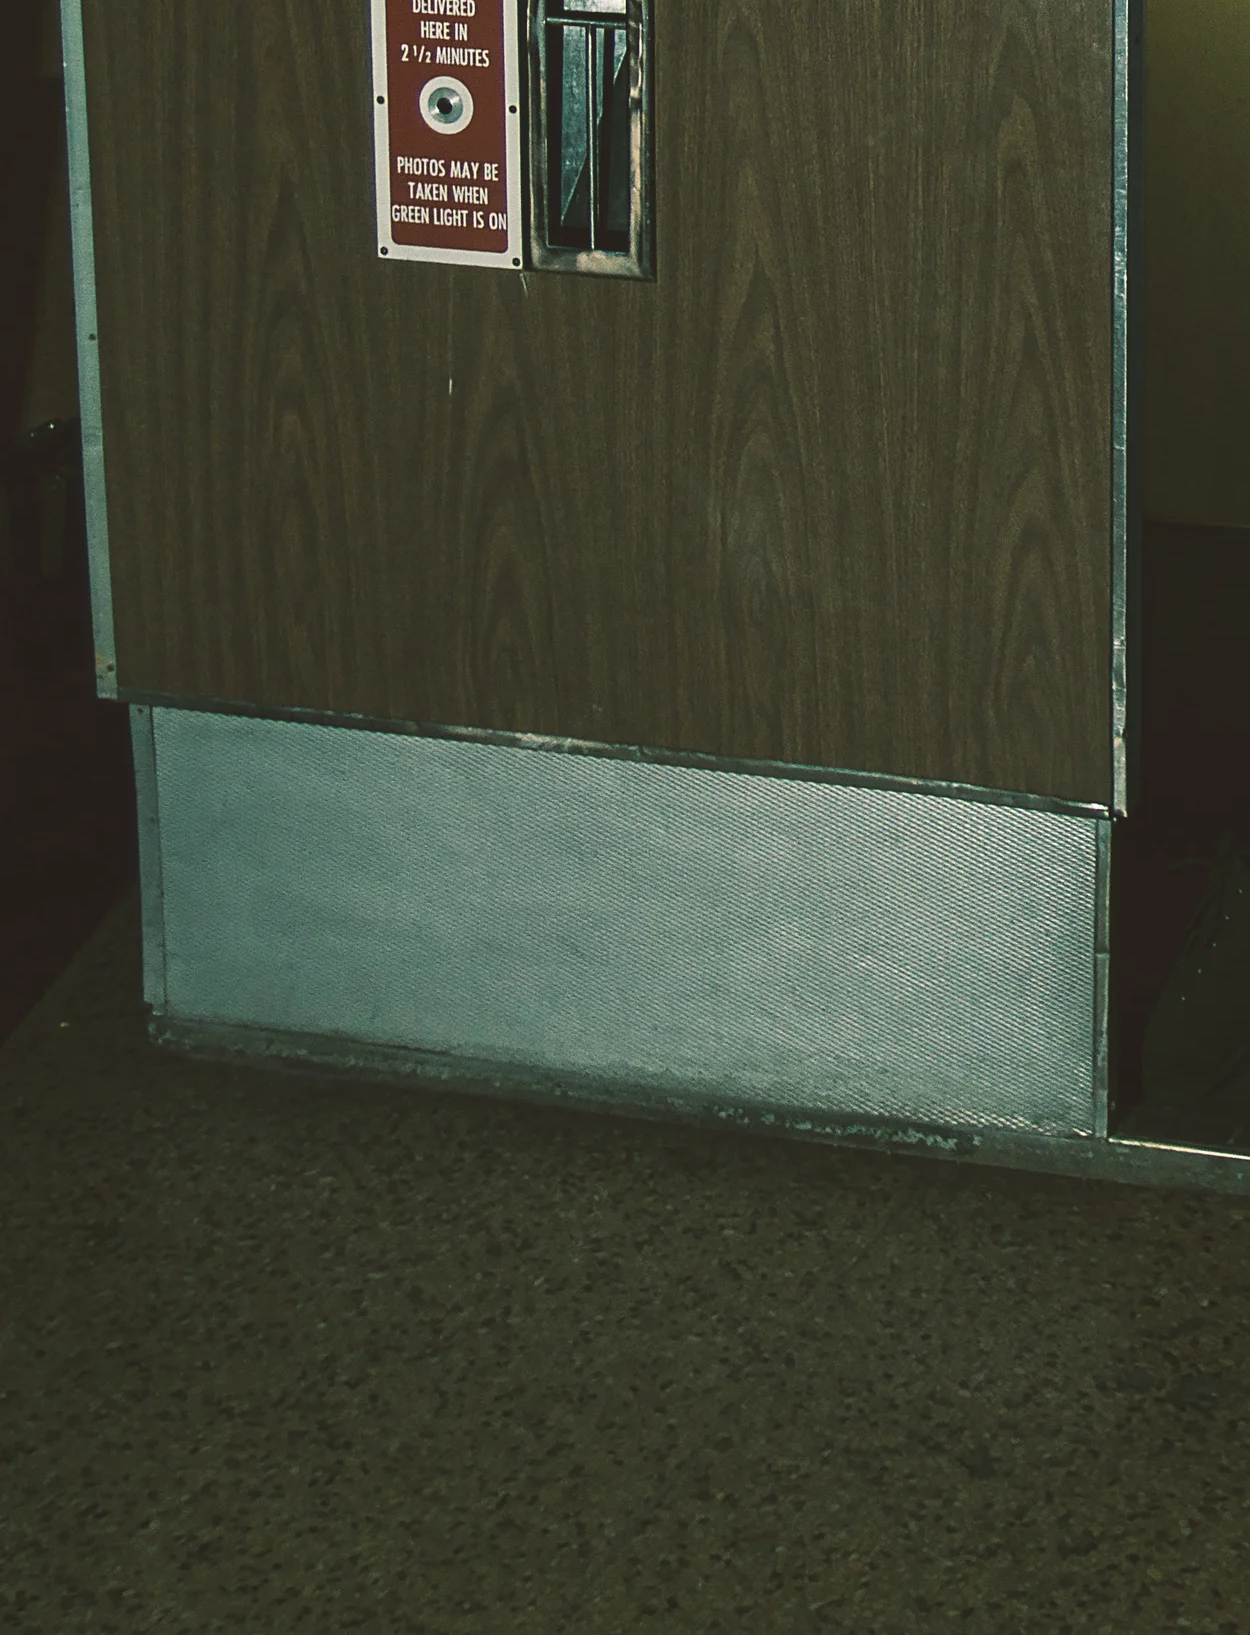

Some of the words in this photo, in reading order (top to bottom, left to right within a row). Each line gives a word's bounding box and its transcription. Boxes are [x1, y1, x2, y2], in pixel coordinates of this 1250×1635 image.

[420, 20, 451, 41] HERE
[454, 22, 468, 42] IN
[435, 45, 490, 68] MINUTES
[396, 156, 446, 178] PHOTOS
[449, 160, 480, 180] MAY
[483, 163, 499, 182] BE
[407, 181, 449, 202] TAKEN
[452, 184, 489, 206] WHEN
[391, 204, 430, 225] GREEN
[433, 207, 469, 229] LIGHT
[473, 210, 485, 229] IS
[488, 212, 508, 232] ON
